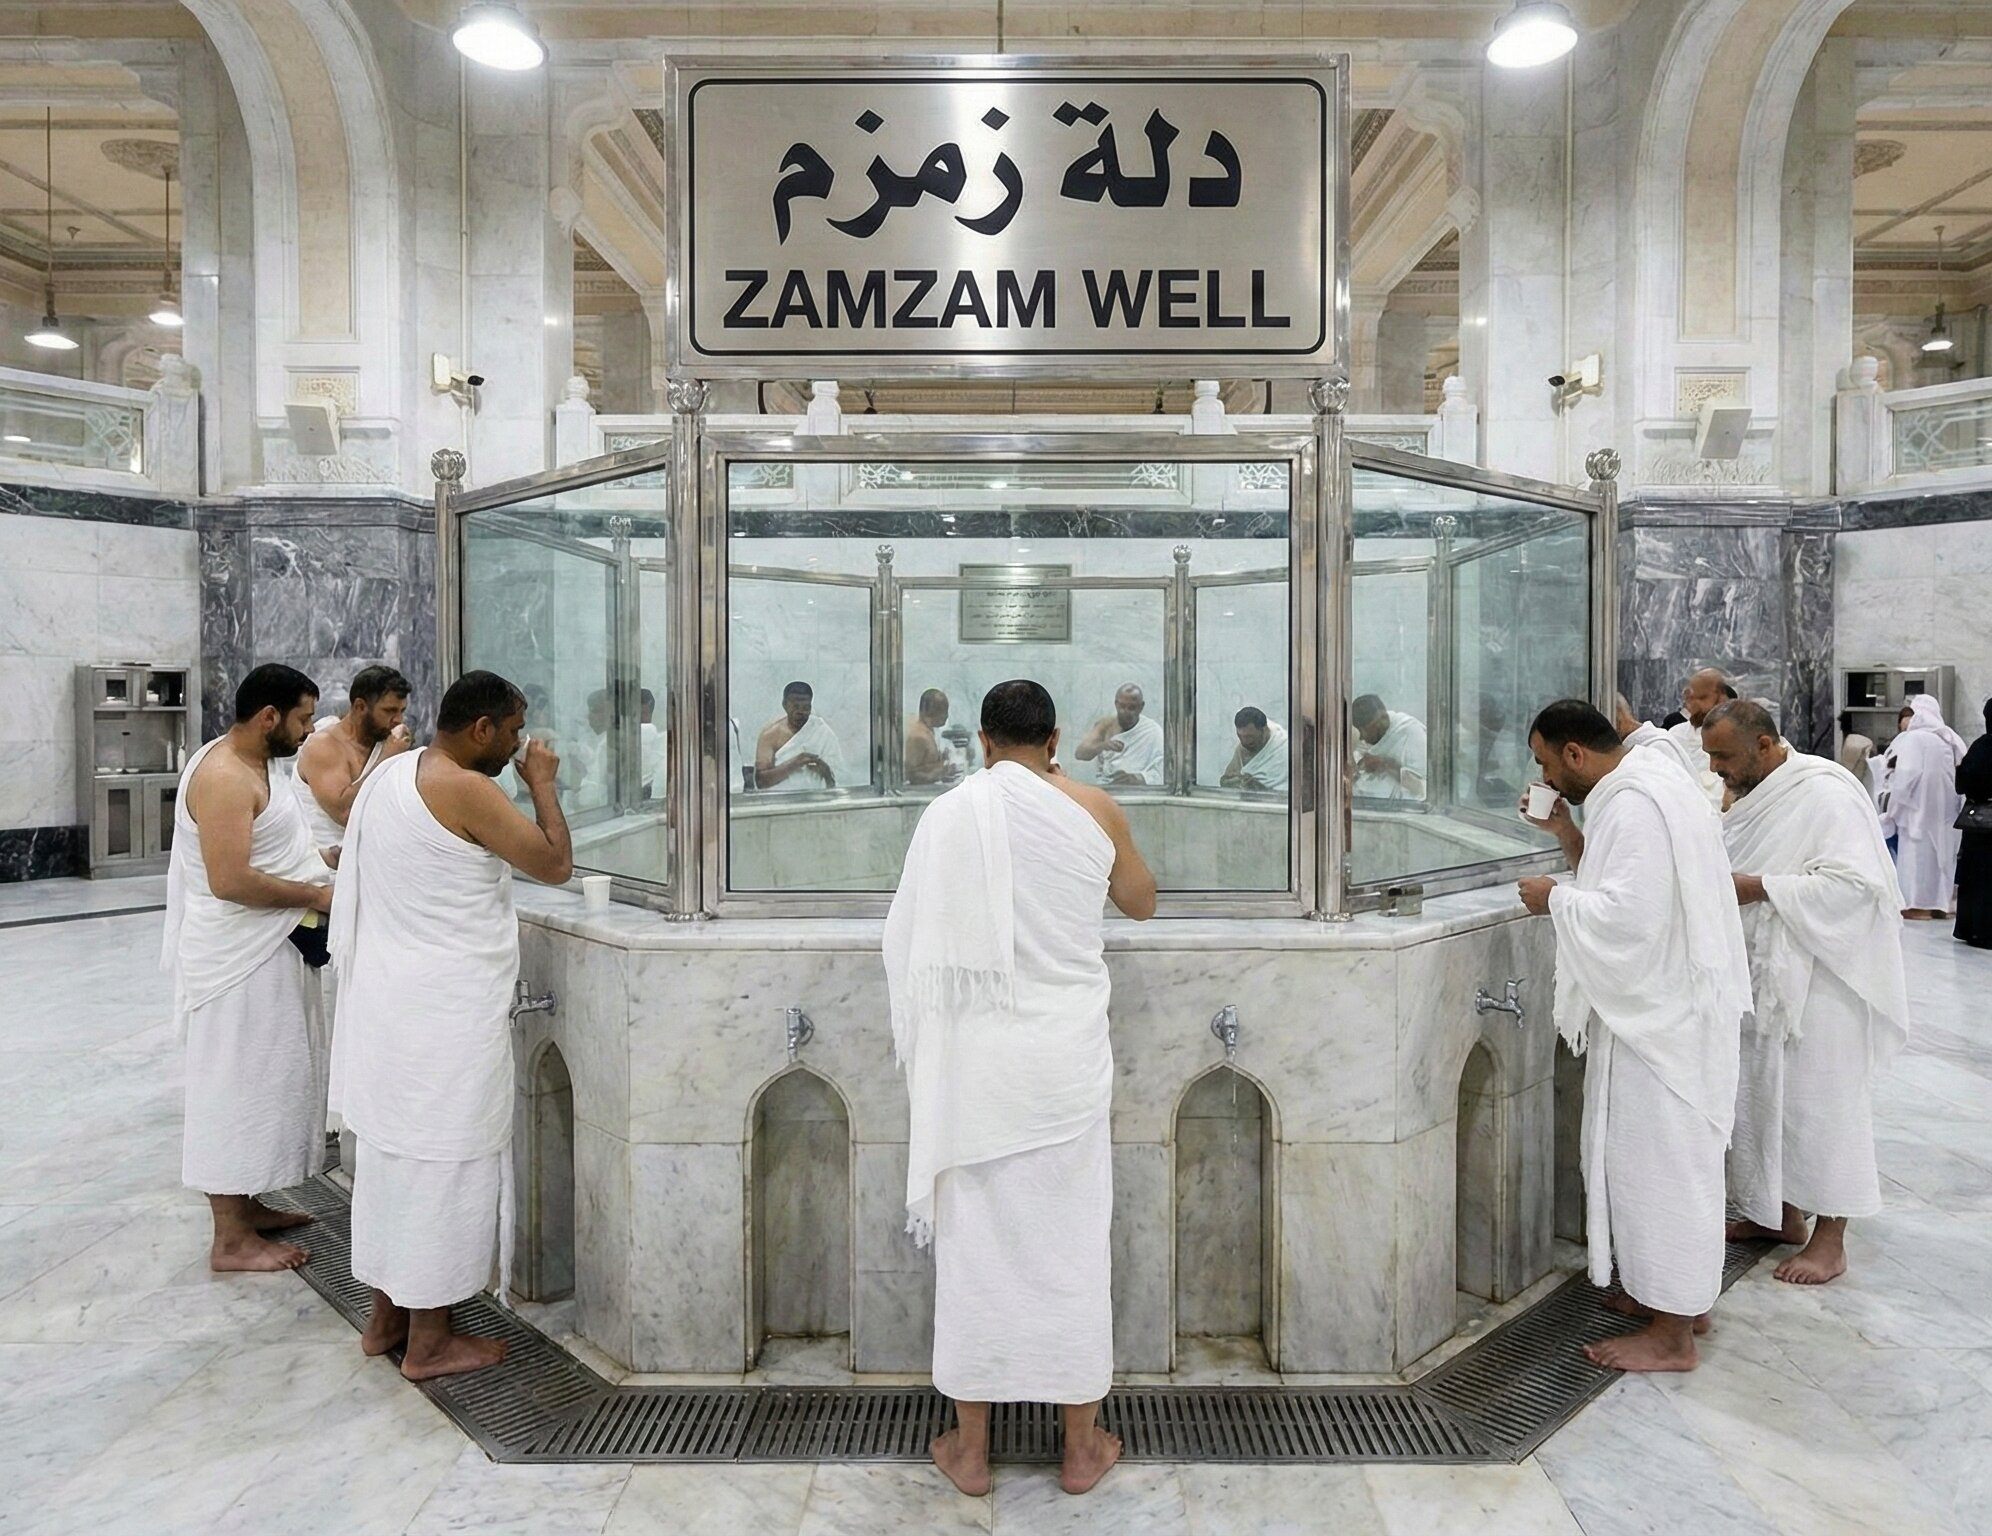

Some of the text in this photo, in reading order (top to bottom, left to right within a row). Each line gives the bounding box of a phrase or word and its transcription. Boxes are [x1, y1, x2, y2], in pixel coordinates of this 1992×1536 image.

[772, 101, 1242, 246] دلة زمزم
[723, 269, 1291, 329] ZAMZAM WELL
